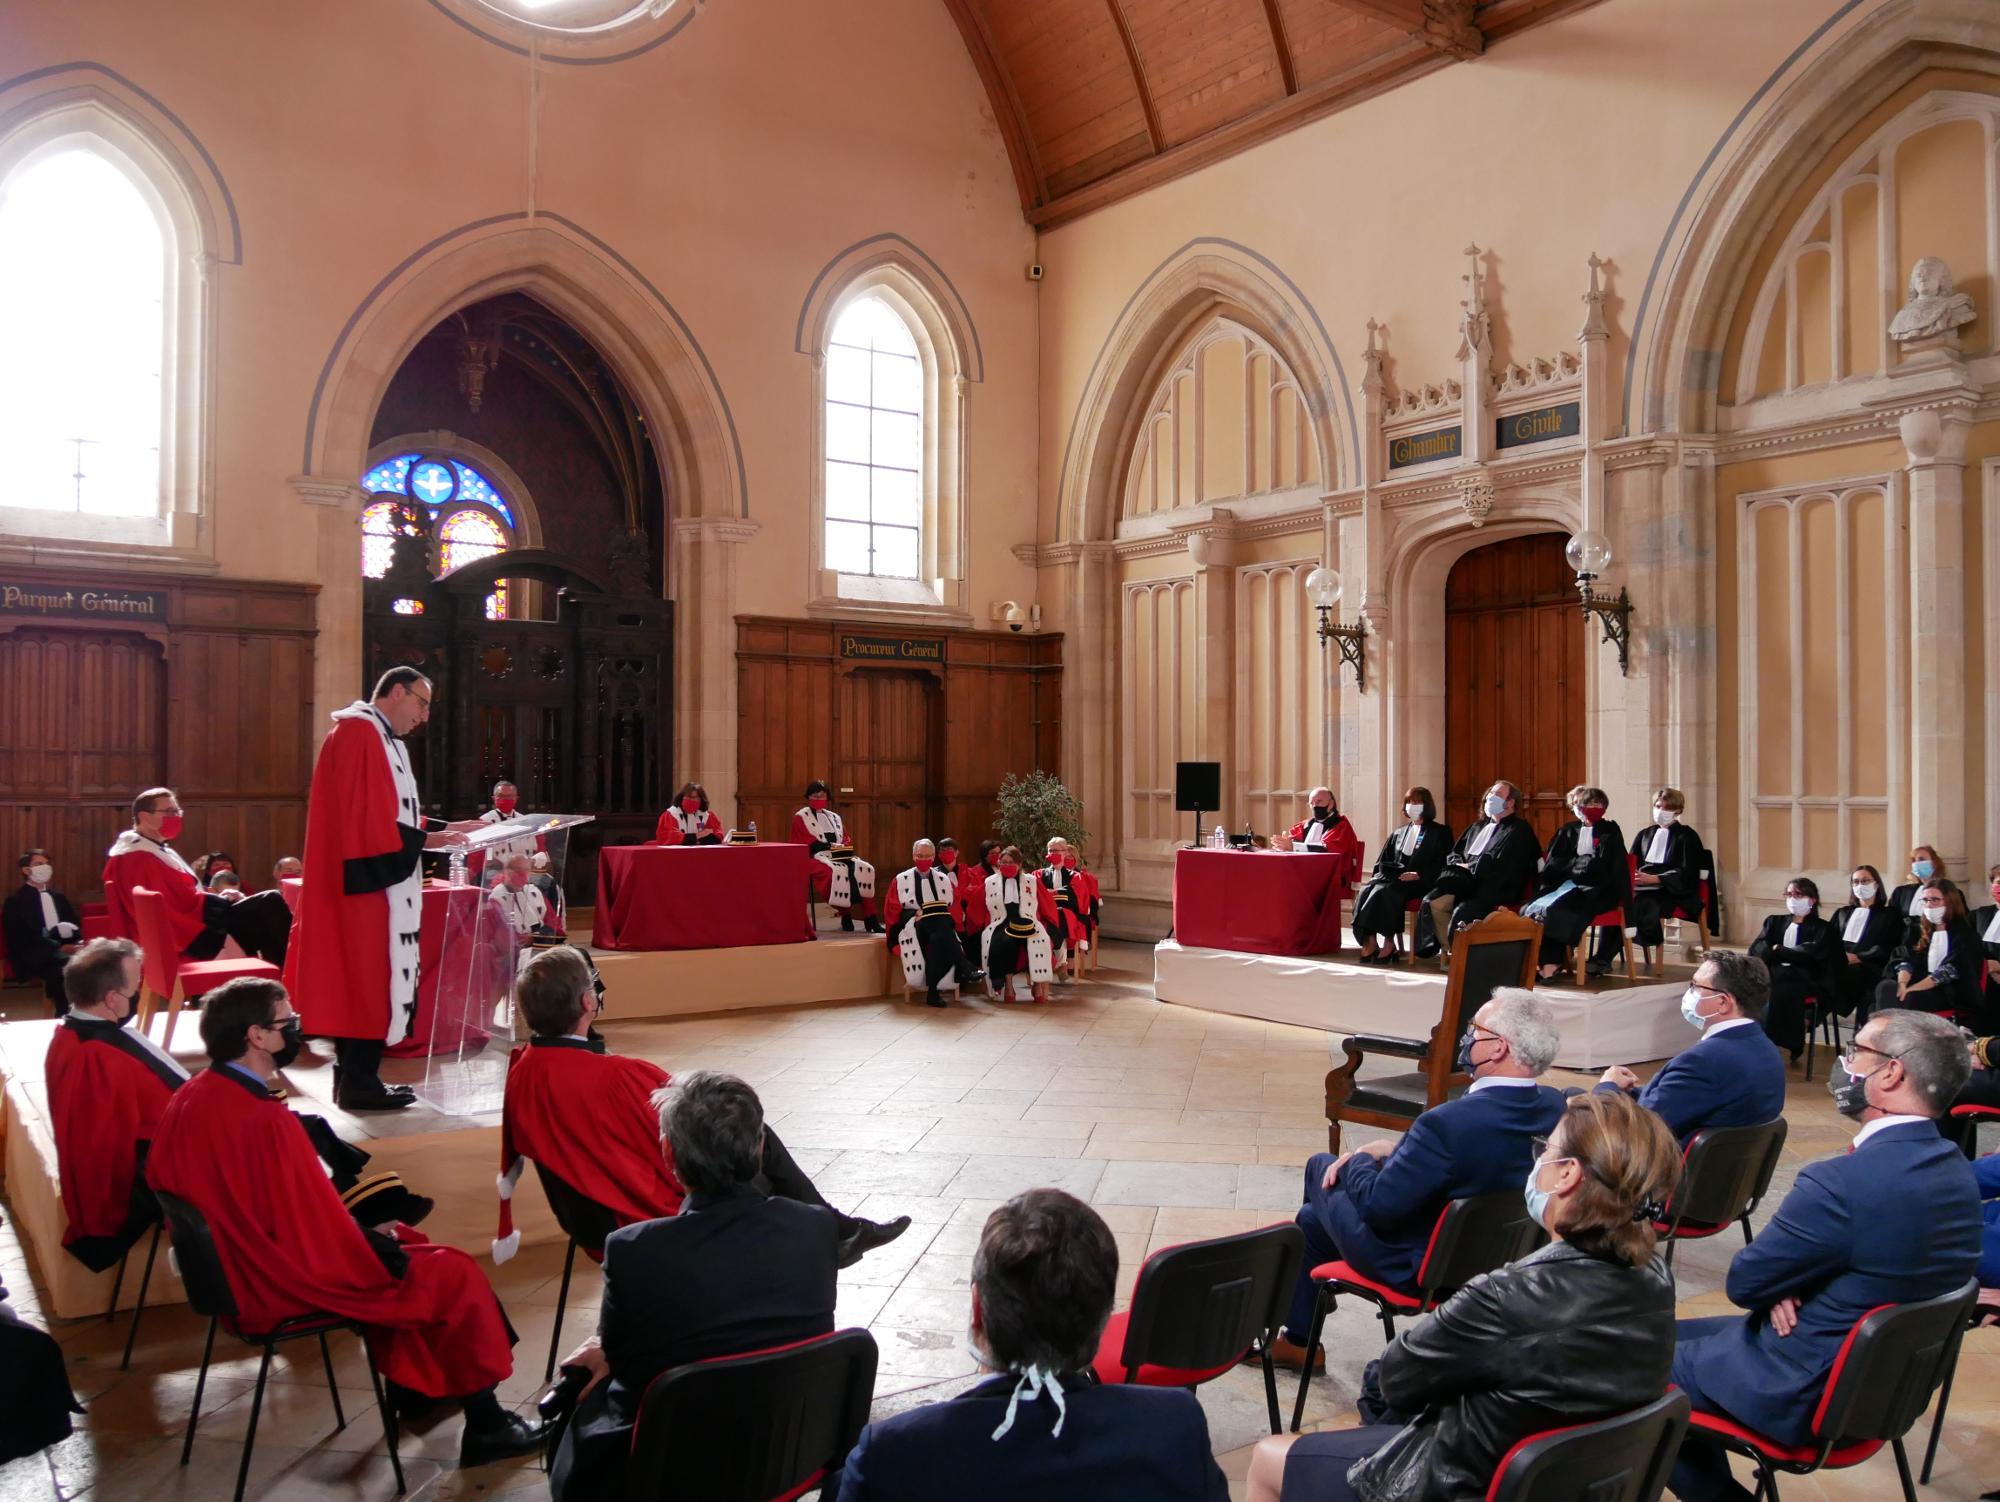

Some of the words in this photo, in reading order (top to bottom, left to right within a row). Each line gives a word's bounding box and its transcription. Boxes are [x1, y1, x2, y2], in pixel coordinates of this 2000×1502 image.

[1515, 408, 1562, 439] Civile
[1394, 431, 1456, 463] Chambre
[2, 586, 74, 612] Parquet
[81, 592, 154, 613] Général
[843, 638, 896, 656] Procureur
